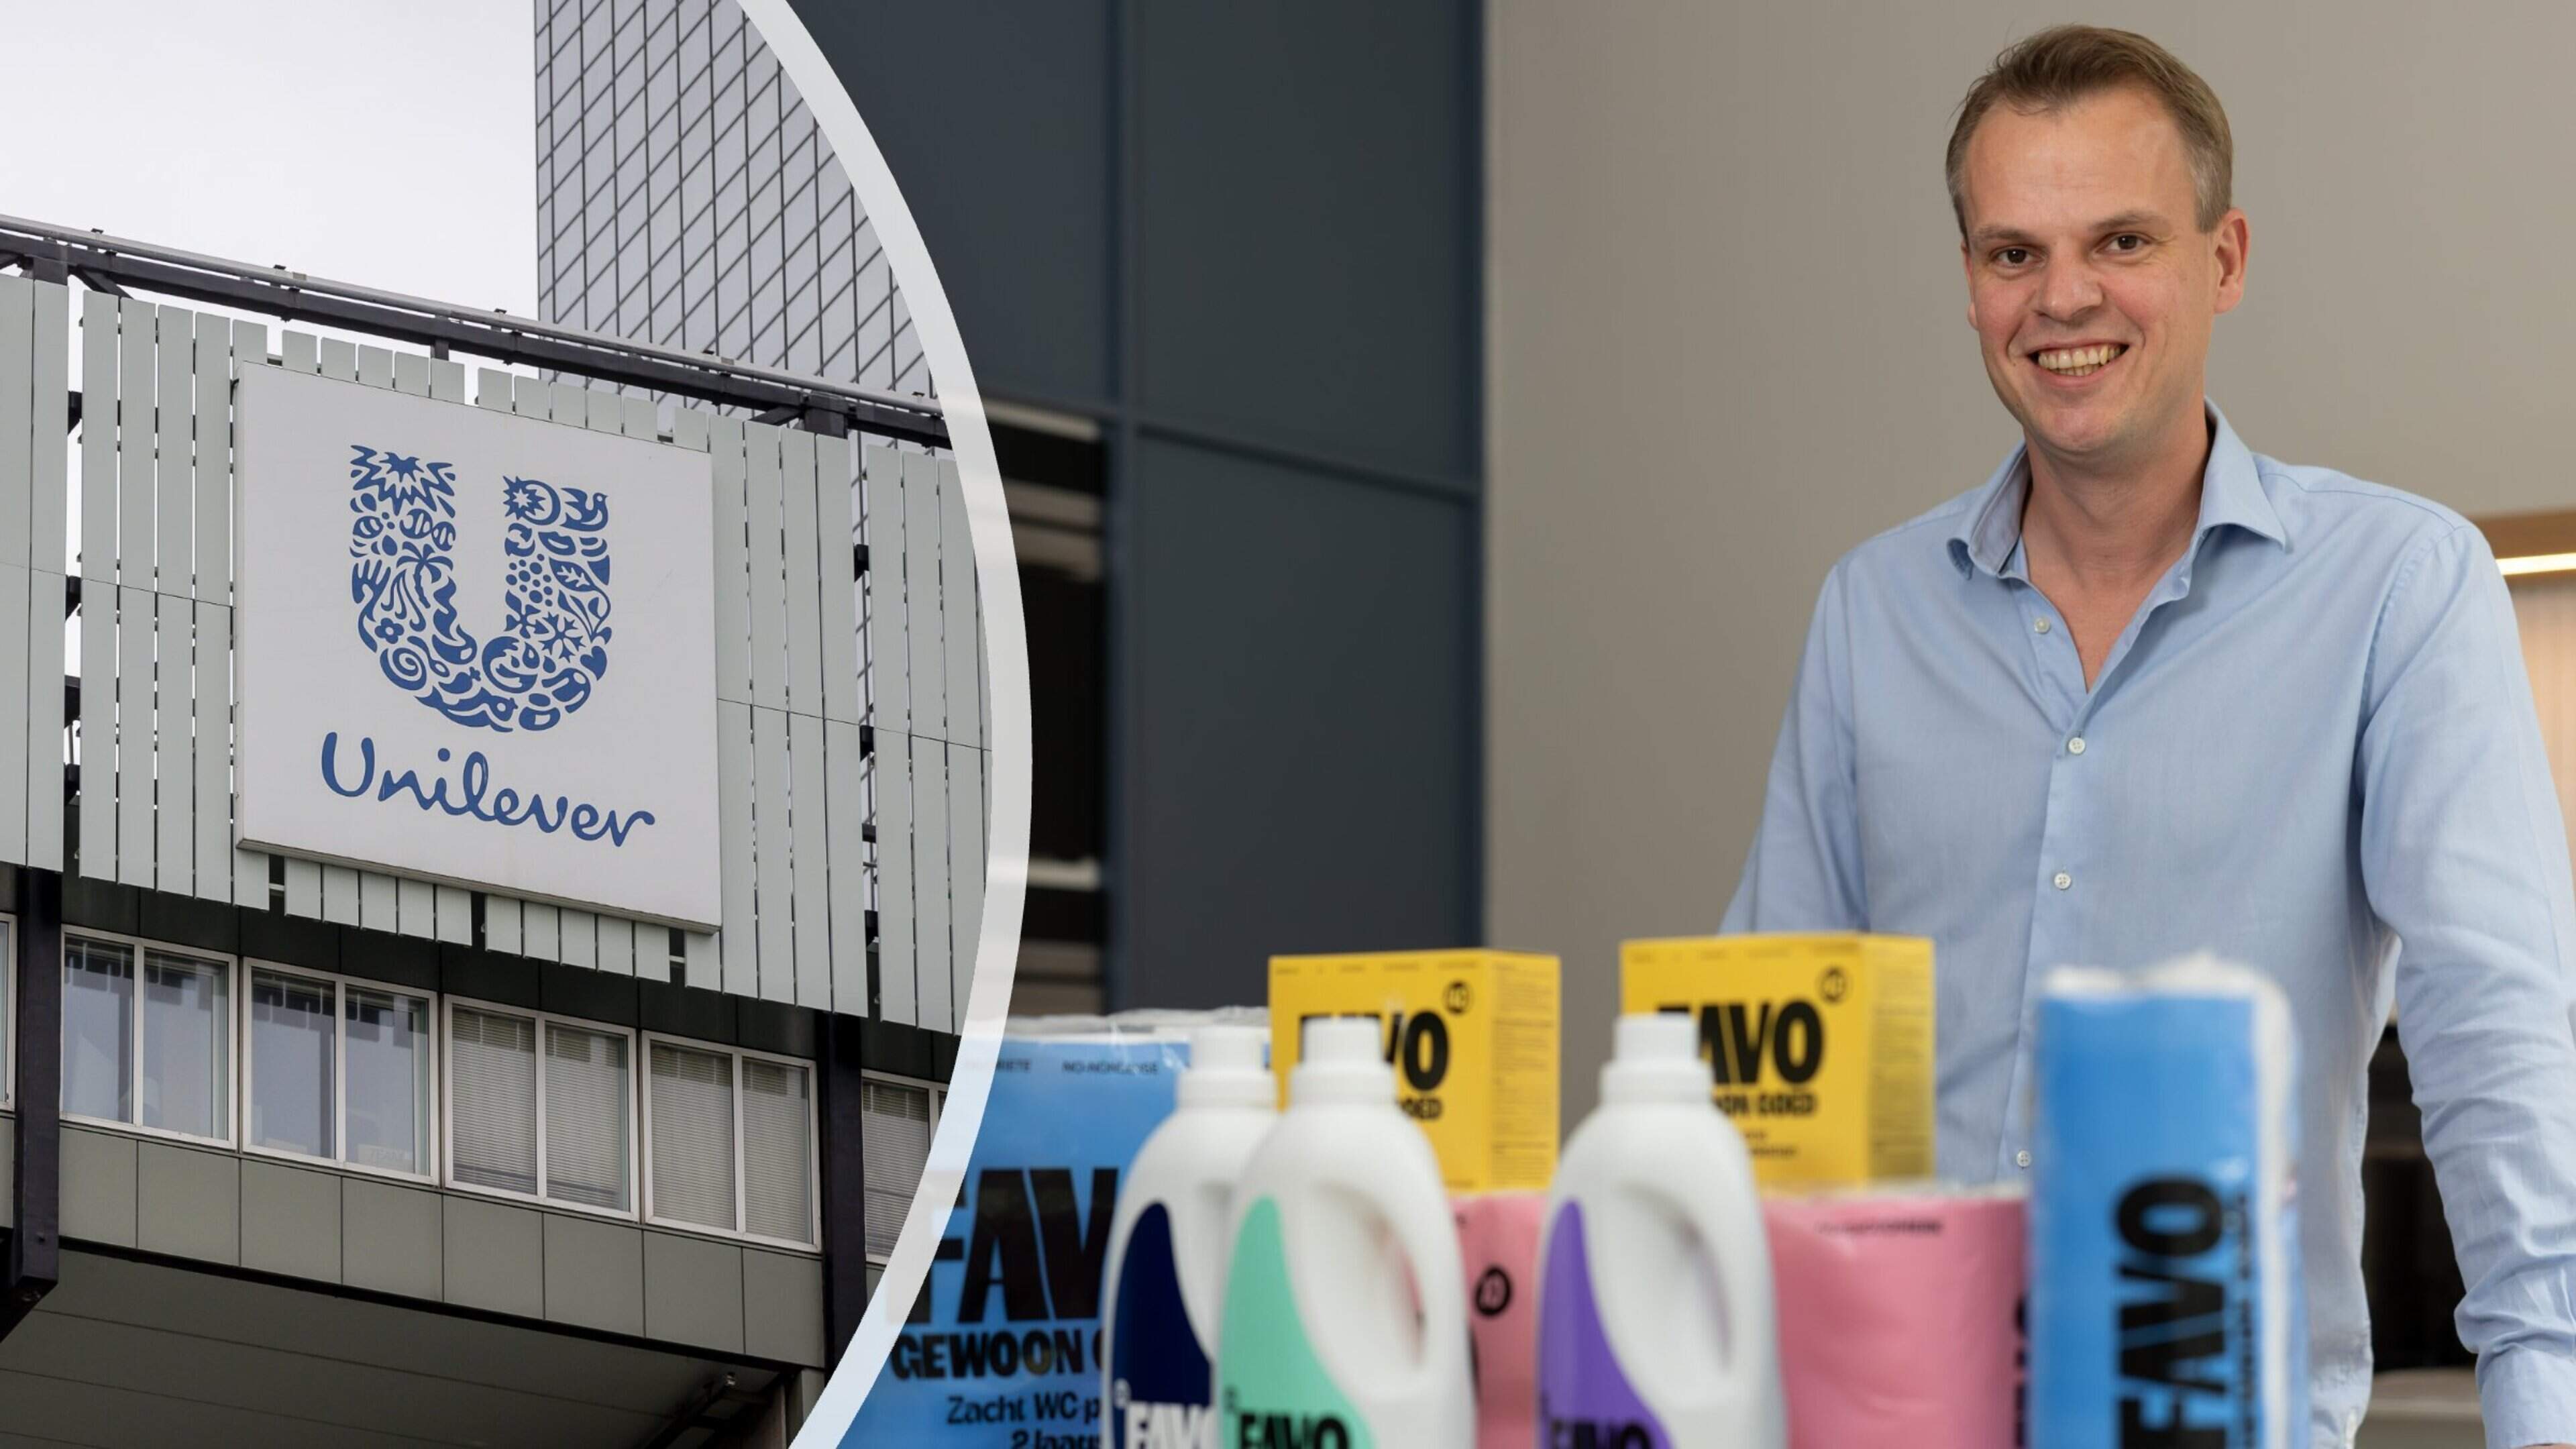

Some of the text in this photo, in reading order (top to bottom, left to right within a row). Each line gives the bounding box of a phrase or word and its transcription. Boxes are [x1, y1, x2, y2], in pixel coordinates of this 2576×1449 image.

[321, 731, 655, 847] Unilever
[1657, 998, 1825, 1087] AVO
[887, 1167, 1119, 1325] FAV
[890, 1328, 1085, 1381] GEWOON
[2113, 1176, 2227, 1449] FAVO
[947, 1394, 1026, 1425] Zacht
[1034, 1389, 1078, 1421] WC
[1126, 1399, 1216, 1449] FAV
